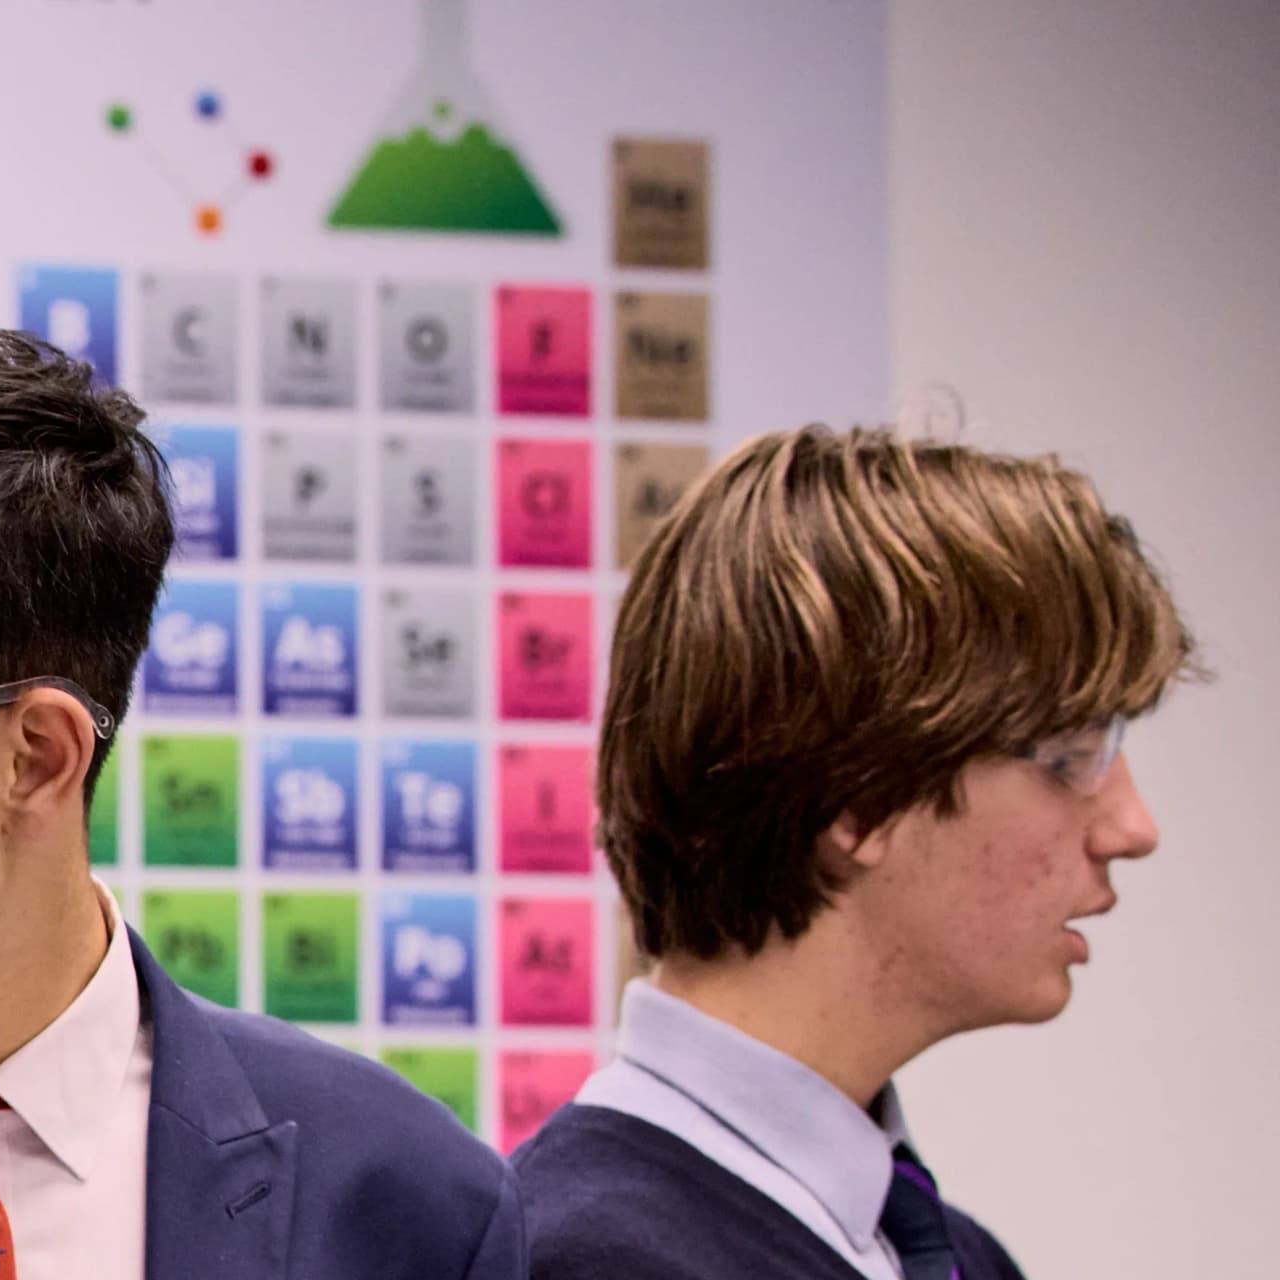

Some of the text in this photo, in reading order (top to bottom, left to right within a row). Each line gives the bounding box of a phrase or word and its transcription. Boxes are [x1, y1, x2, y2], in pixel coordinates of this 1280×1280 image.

[174, 310, 202, 355] C
[289, 316, 328, 355] N
[407, 316, 446, 359] O
